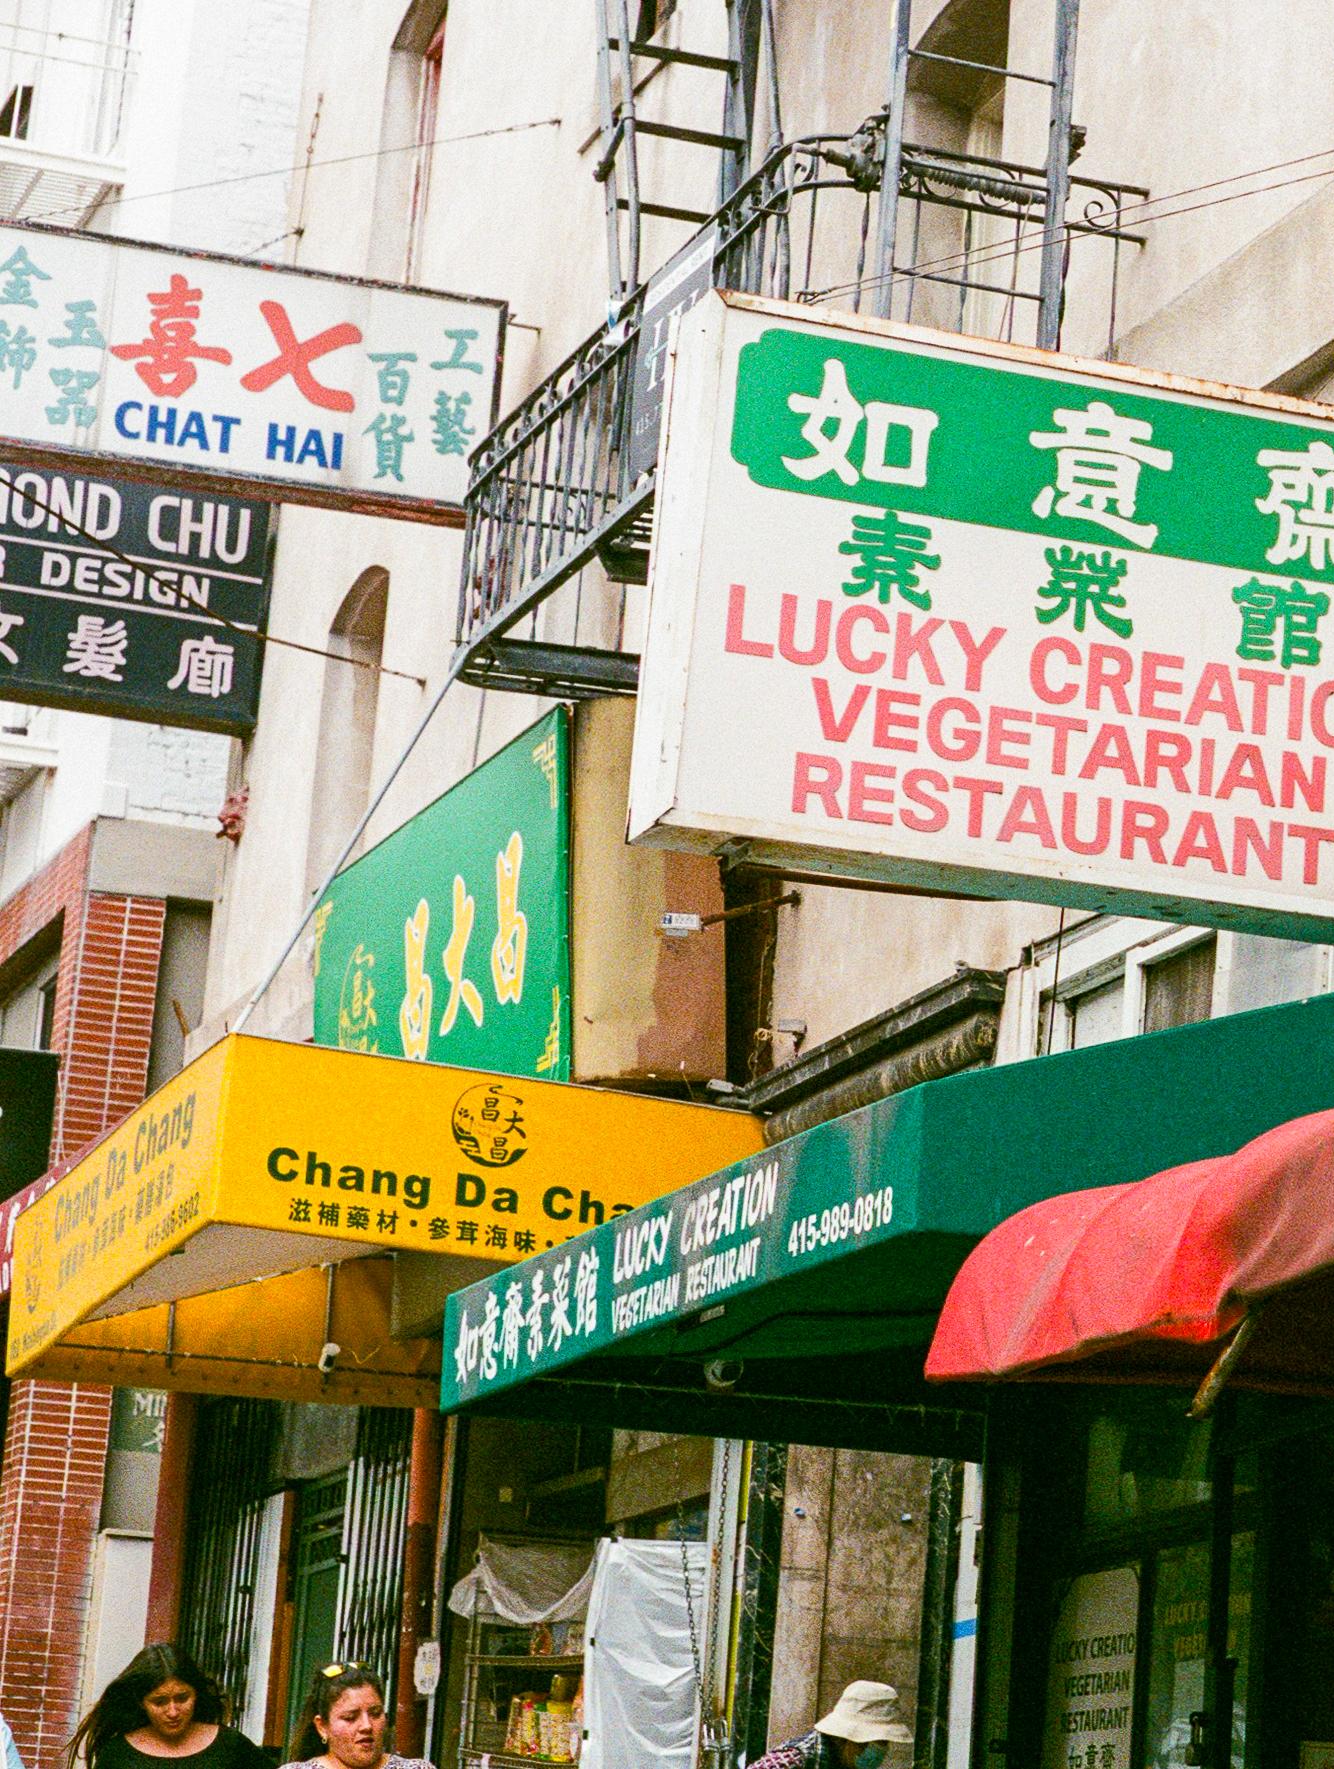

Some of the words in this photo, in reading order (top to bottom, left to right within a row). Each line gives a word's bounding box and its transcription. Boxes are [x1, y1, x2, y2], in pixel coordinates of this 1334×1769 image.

[45, 299, 106, 429] 玉器
[430, 328, 484, 455] 工藝
[115, 400, 241, 454] CHAT
[266, 422, 344, 470] HAI
[362, 352, 418, 482] 百貨
[147, 495, 251, 564] CHU
[40, 551, 210, 609] DESIGN
[837, 509, 1331, 669] 素菜館
[723, 583, 1008, 692] LUCKY
[811, 677, 1329, 814] VEGETARIAN
[133, 1092, 197, 1175] Chang
[266, 1147, 431, 1210] Chang
[455, 1173, 518, 1214] Da
[613, 1210, 673, 1284] LUCKY
[680, 1161, 780, 1256] CREATION
[788, 1186, 894, 1257] 415-989-0818
[612, 1273, 680, 1334] VEGETARIAN
[685, 1237, 761, 1304] RESTAURANT
[1060, 1706, 1130, 1734] RESTAURANT
[1063, 1670, 1131, 1698] VEGETARIAN
